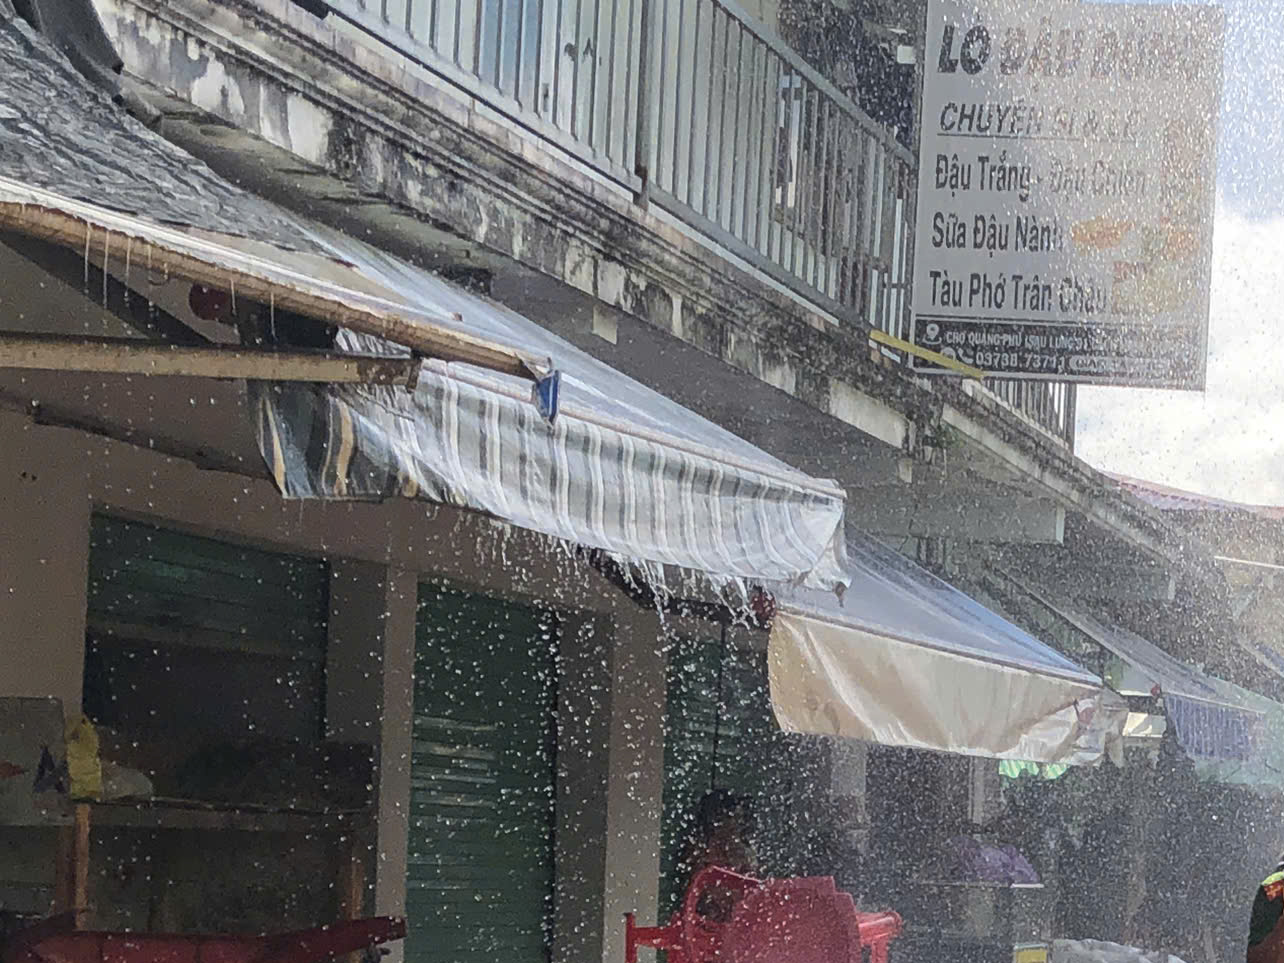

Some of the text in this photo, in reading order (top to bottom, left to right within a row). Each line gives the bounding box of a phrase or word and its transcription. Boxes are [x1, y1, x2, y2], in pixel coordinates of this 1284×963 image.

[935, 153, 971, 198] Đậu
[977, 150, 1031, 202] Trắng
[931, 211, 966, 249] Sữa
[972, 213, 1009, 258] Đậu
[929, 270, 962, 308] Tàu
[1011, 274, 1053, 311] Trân
